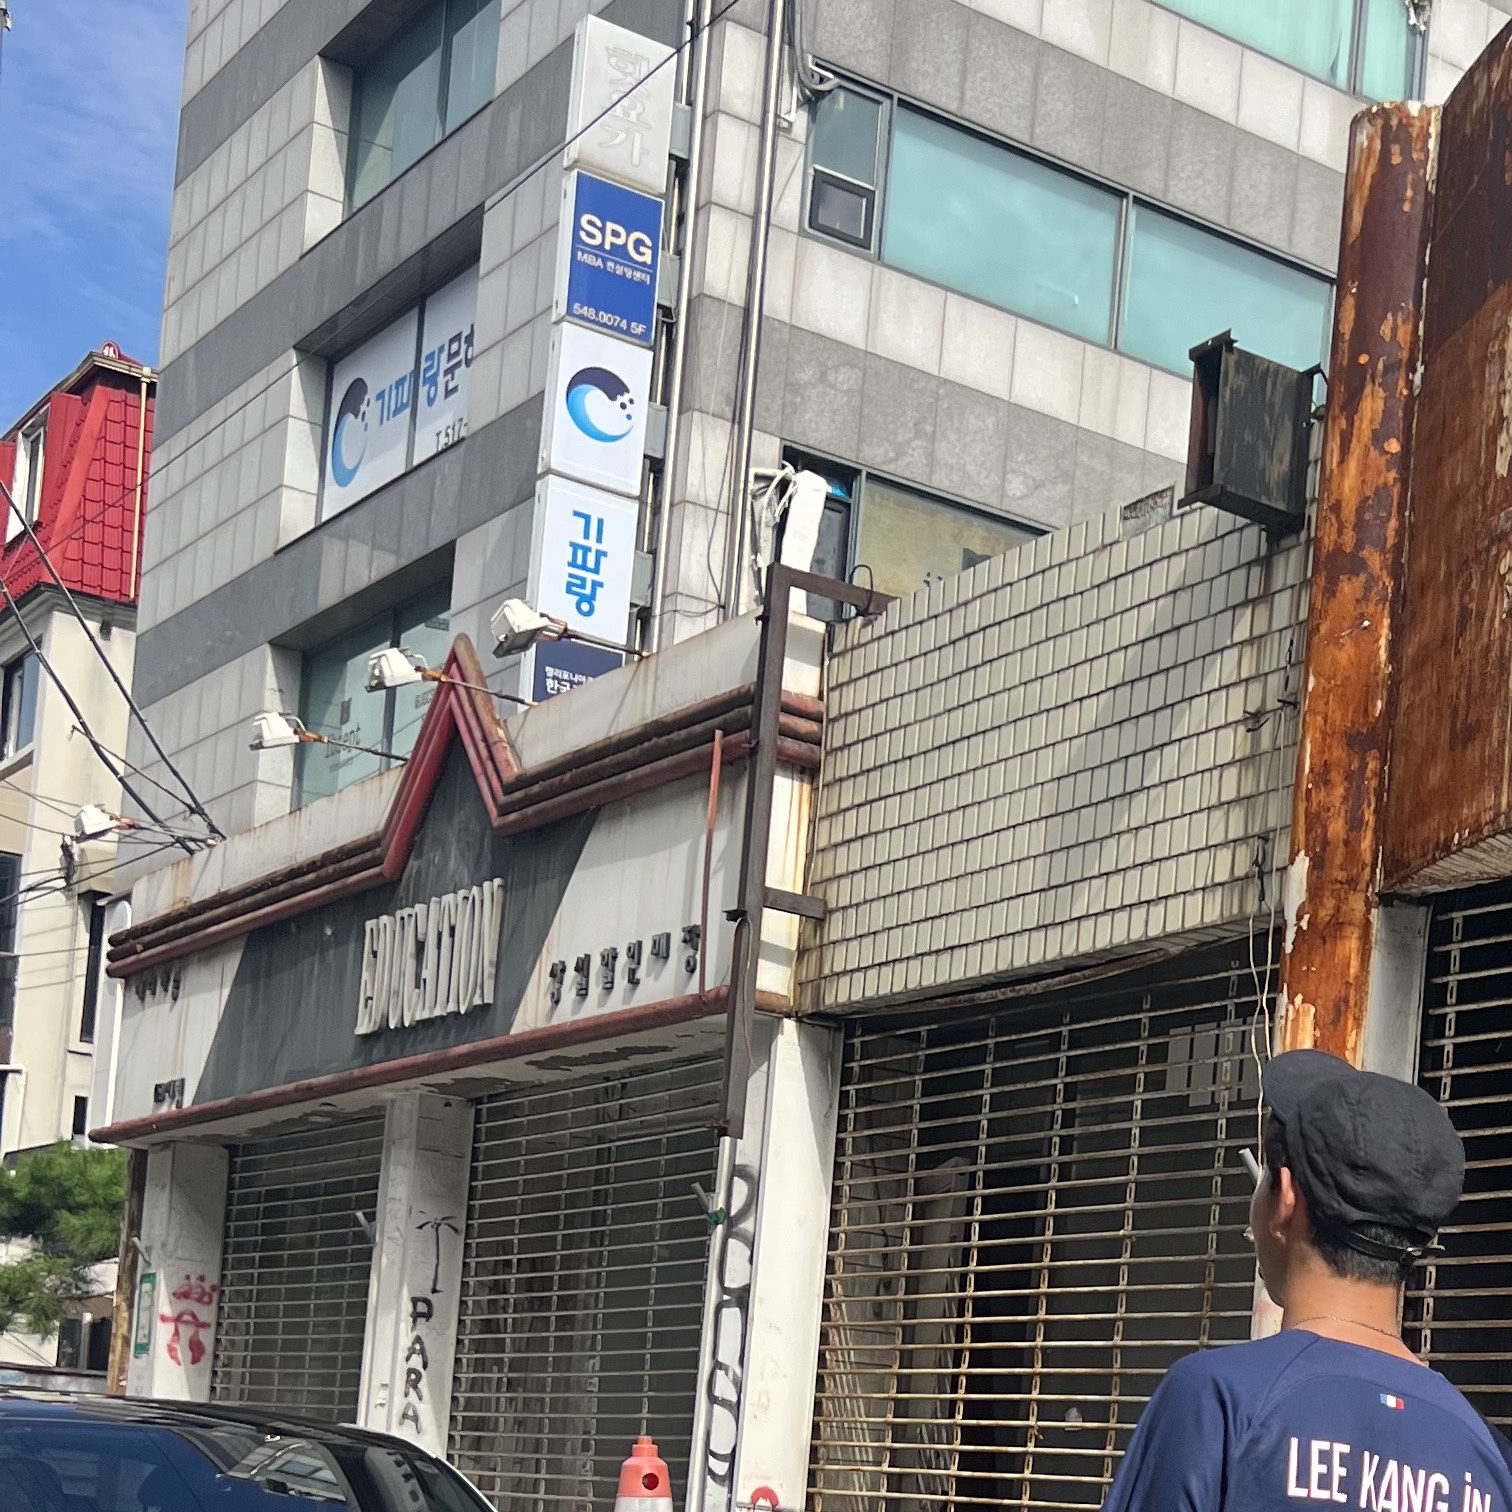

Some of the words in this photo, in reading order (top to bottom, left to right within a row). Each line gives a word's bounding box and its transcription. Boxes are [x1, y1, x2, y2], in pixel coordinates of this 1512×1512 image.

[577, 250, 604, 269] MBA
[579, 213, 653, 265] SPG
[565, 509, 608, 617] 기파랑
[354, 877, 505, 1035] EDUCATION
[1286, 1436, 1352, 1503] LEE
